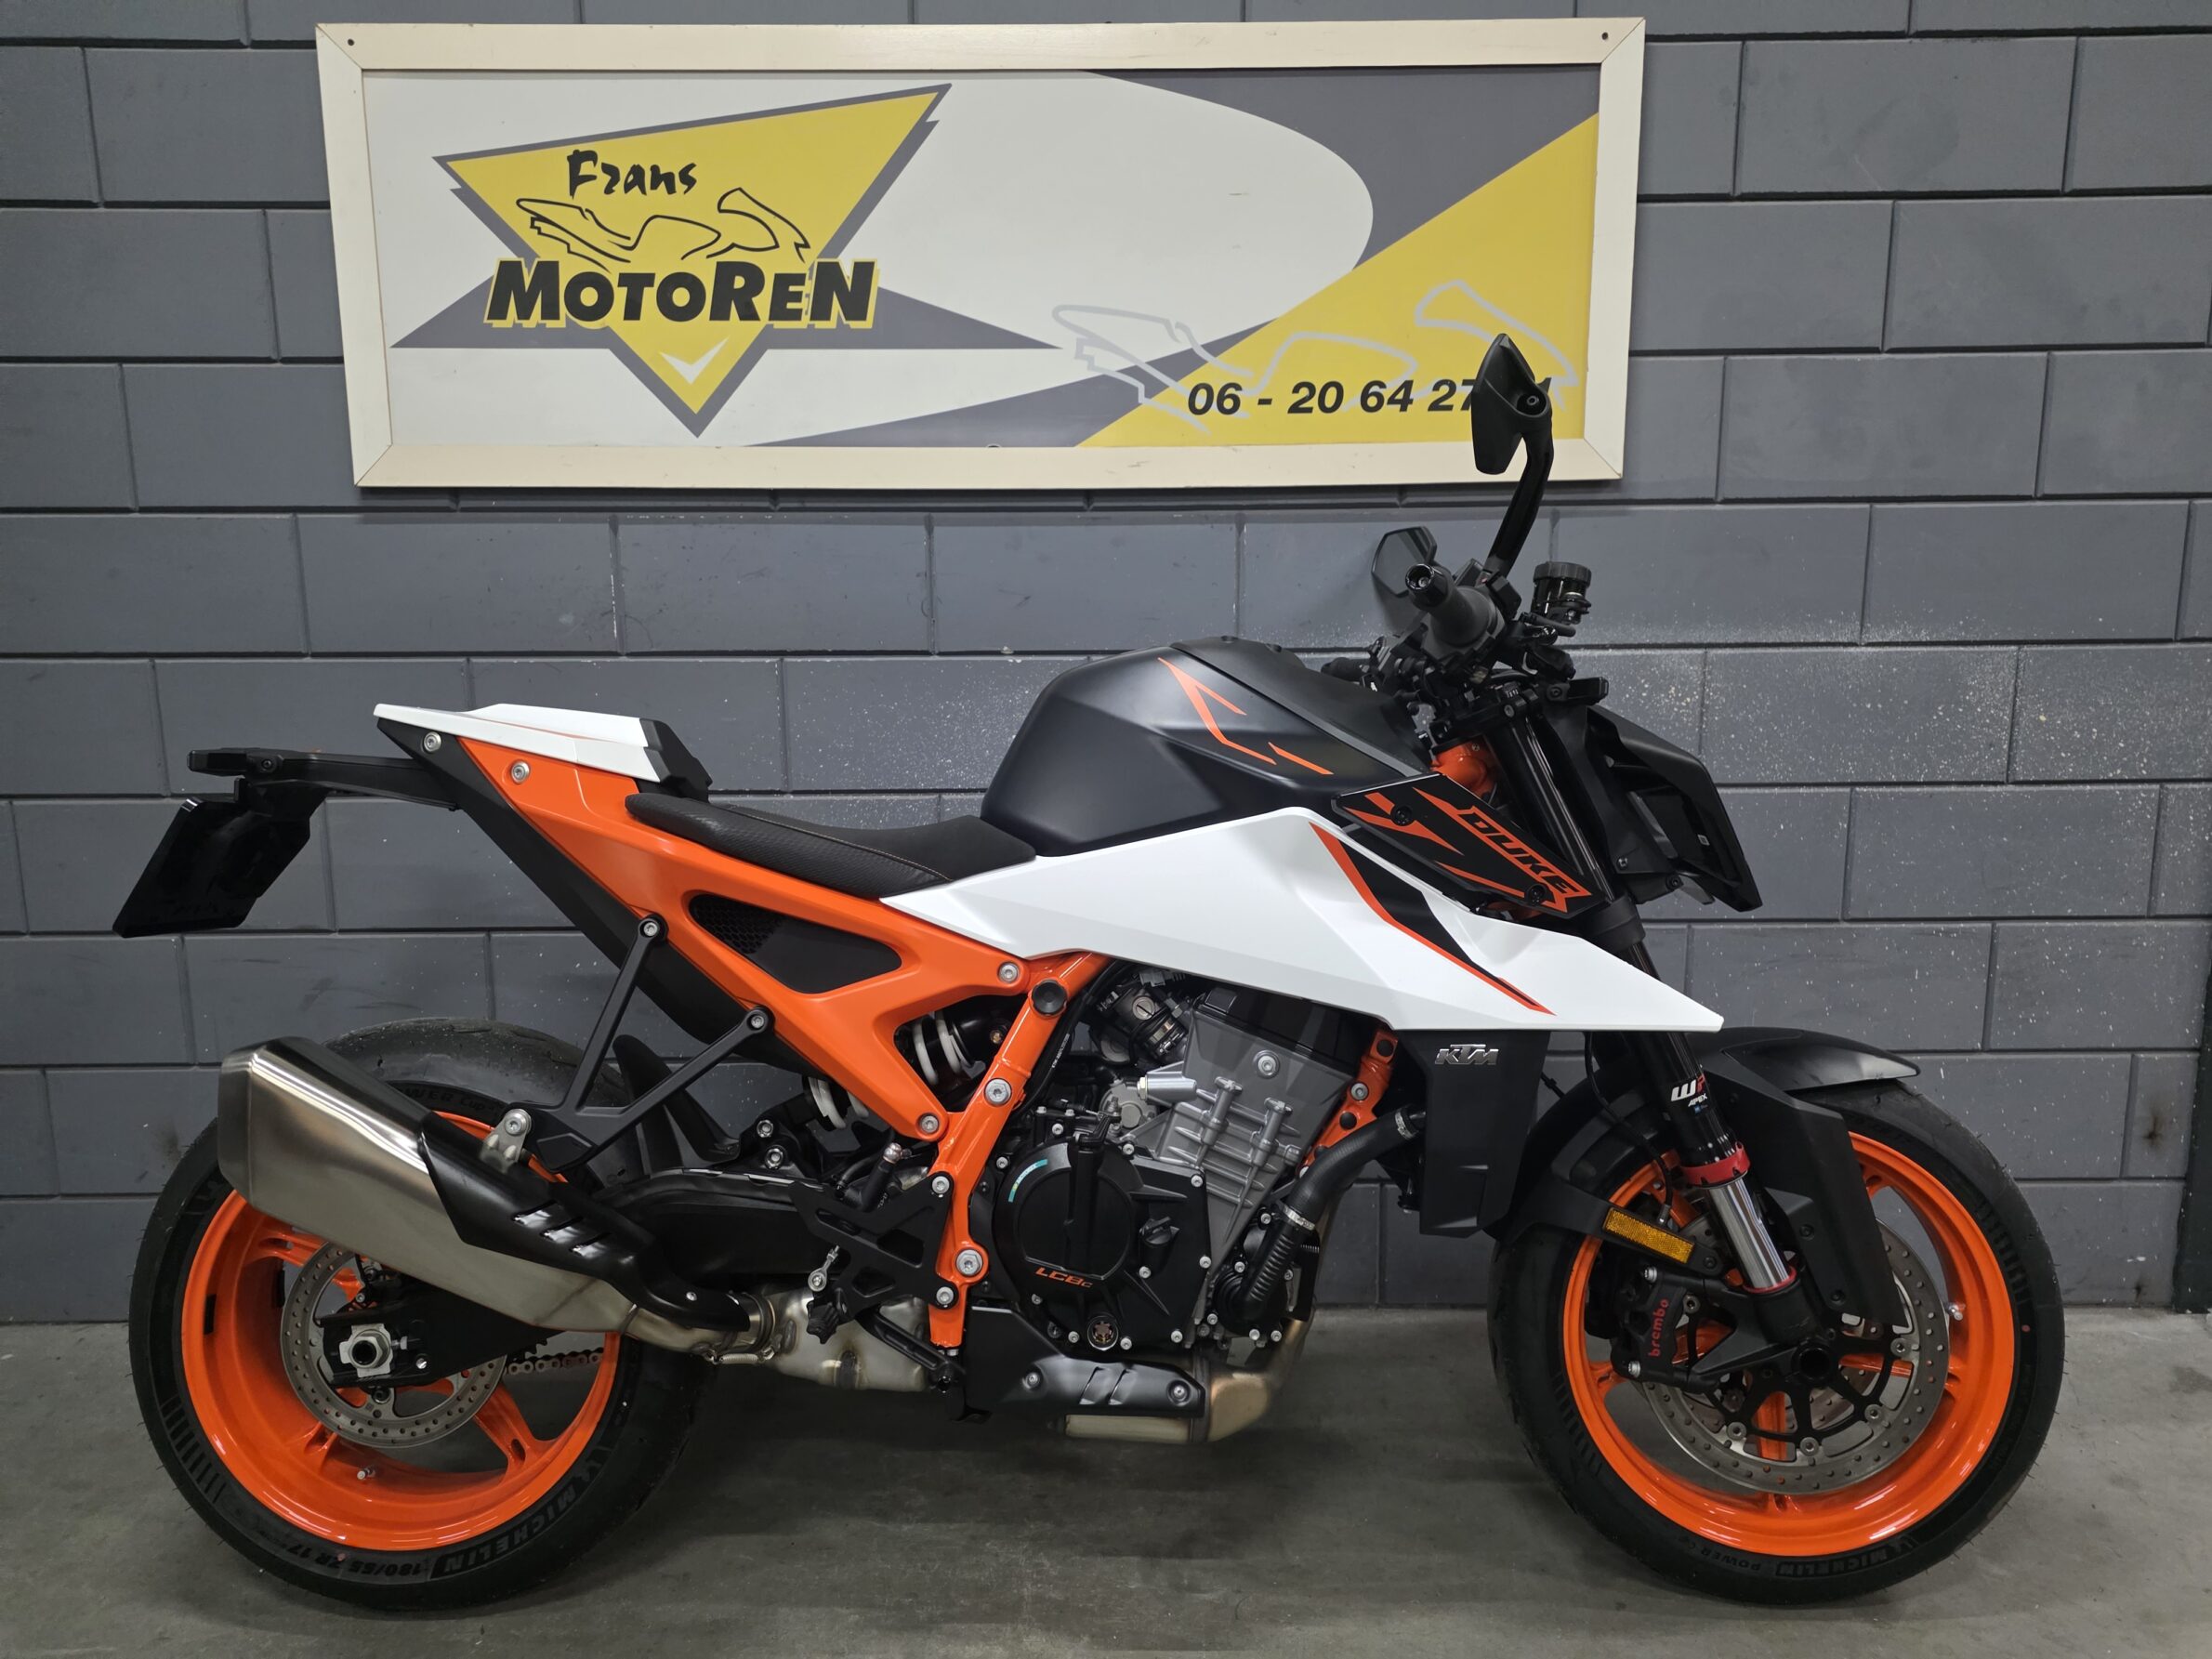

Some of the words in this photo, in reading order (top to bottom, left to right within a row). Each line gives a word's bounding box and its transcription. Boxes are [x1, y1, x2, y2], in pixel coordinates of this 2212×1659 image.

[566, 149, 697, 197] Frans
[1188, 382, 1244, 415] 06
[1287, 381, 1344, 414] 20
[1360, 380, 1415, 413] 64
[1457, 810, 1581, 894] DUKE
[1434, 1043, 1499, 1065] KTM
[1688, 1092, 1708, 1107] APEX
[1647, 1297, 1670, 1358] brembo
[441, 1488, 579, 1573] MICHELIN
[349, 1558, 423, 1576] 180/55
[1701, 1546, 1762, 1571] POWER
[1776, 1547, 1890, 1576] MICHELIN
